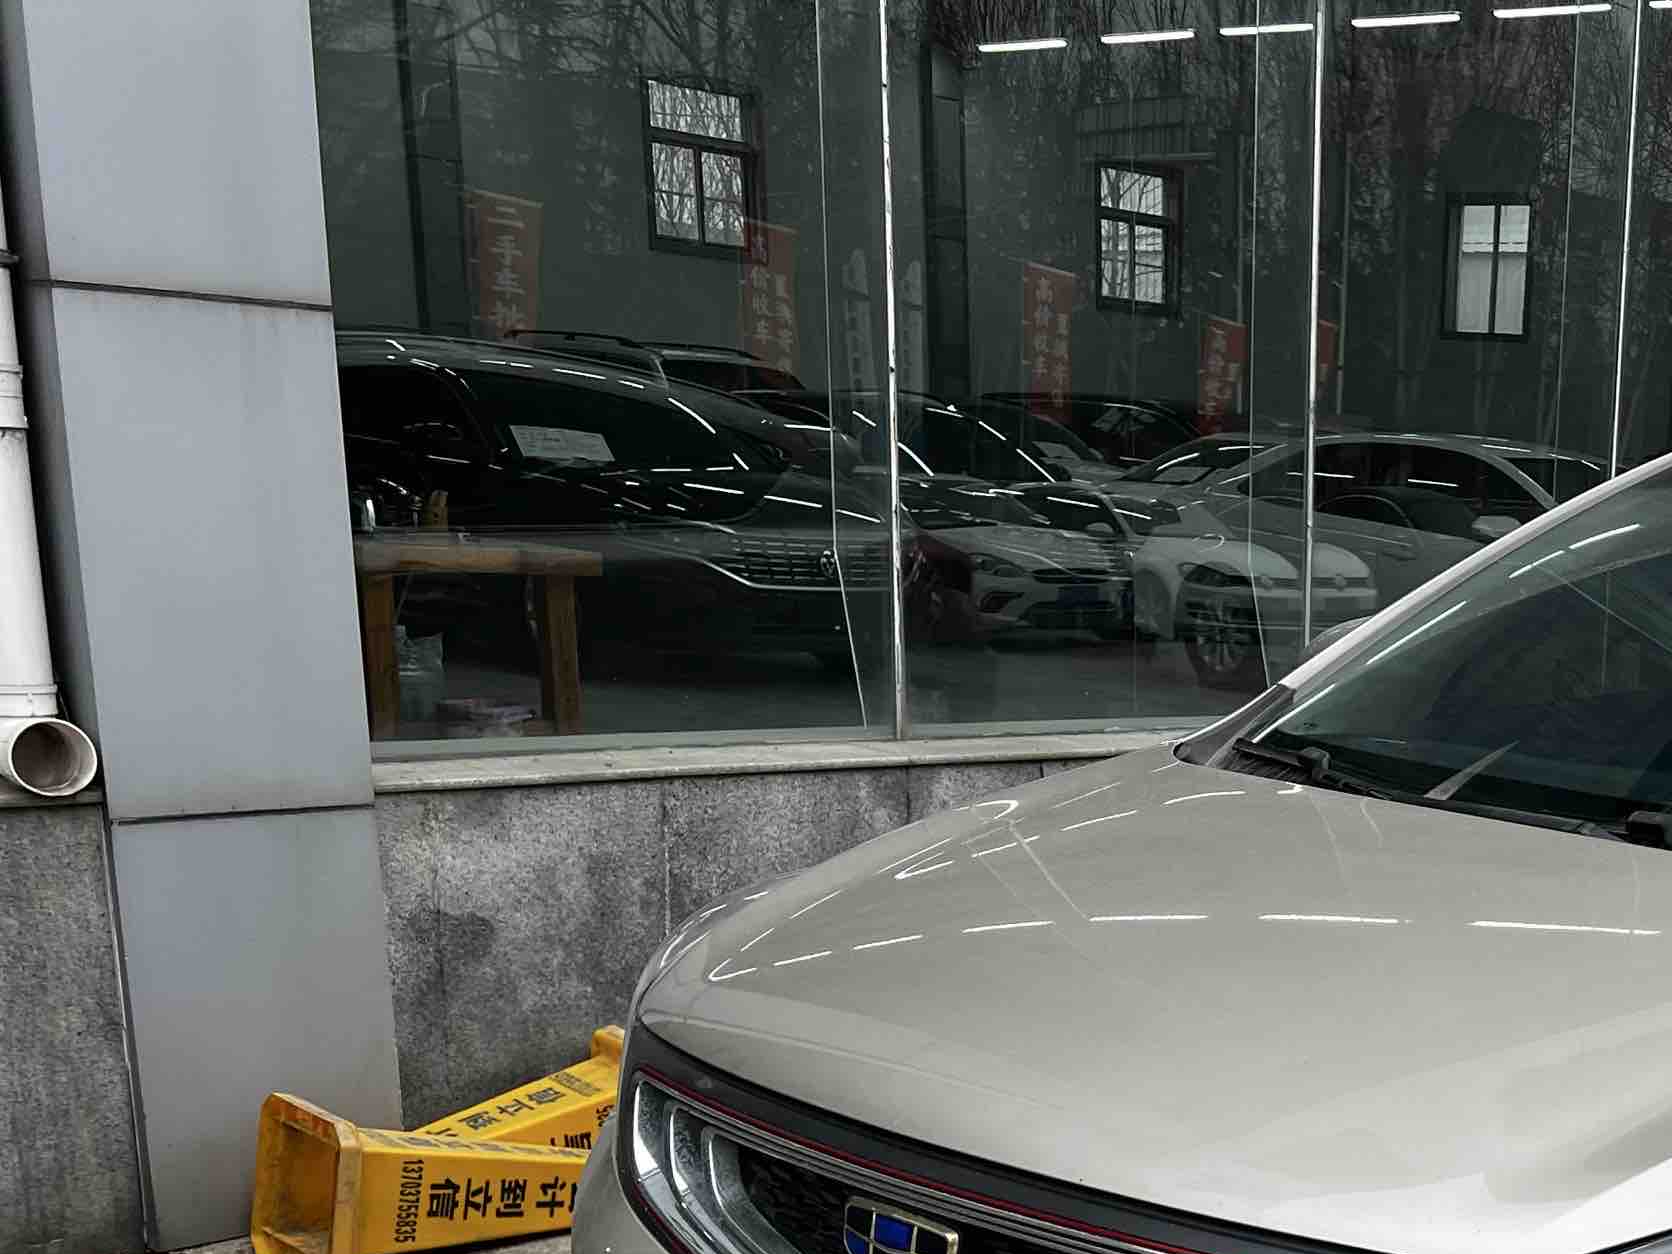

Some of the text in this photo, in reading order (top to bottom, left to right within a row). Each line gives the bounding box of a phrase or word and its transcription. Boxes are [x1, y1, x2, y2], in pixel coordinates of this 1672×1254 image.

[394, 1159, 425, 1243] 13703755835
[427, 1175, 578, 1221] 计到立信
